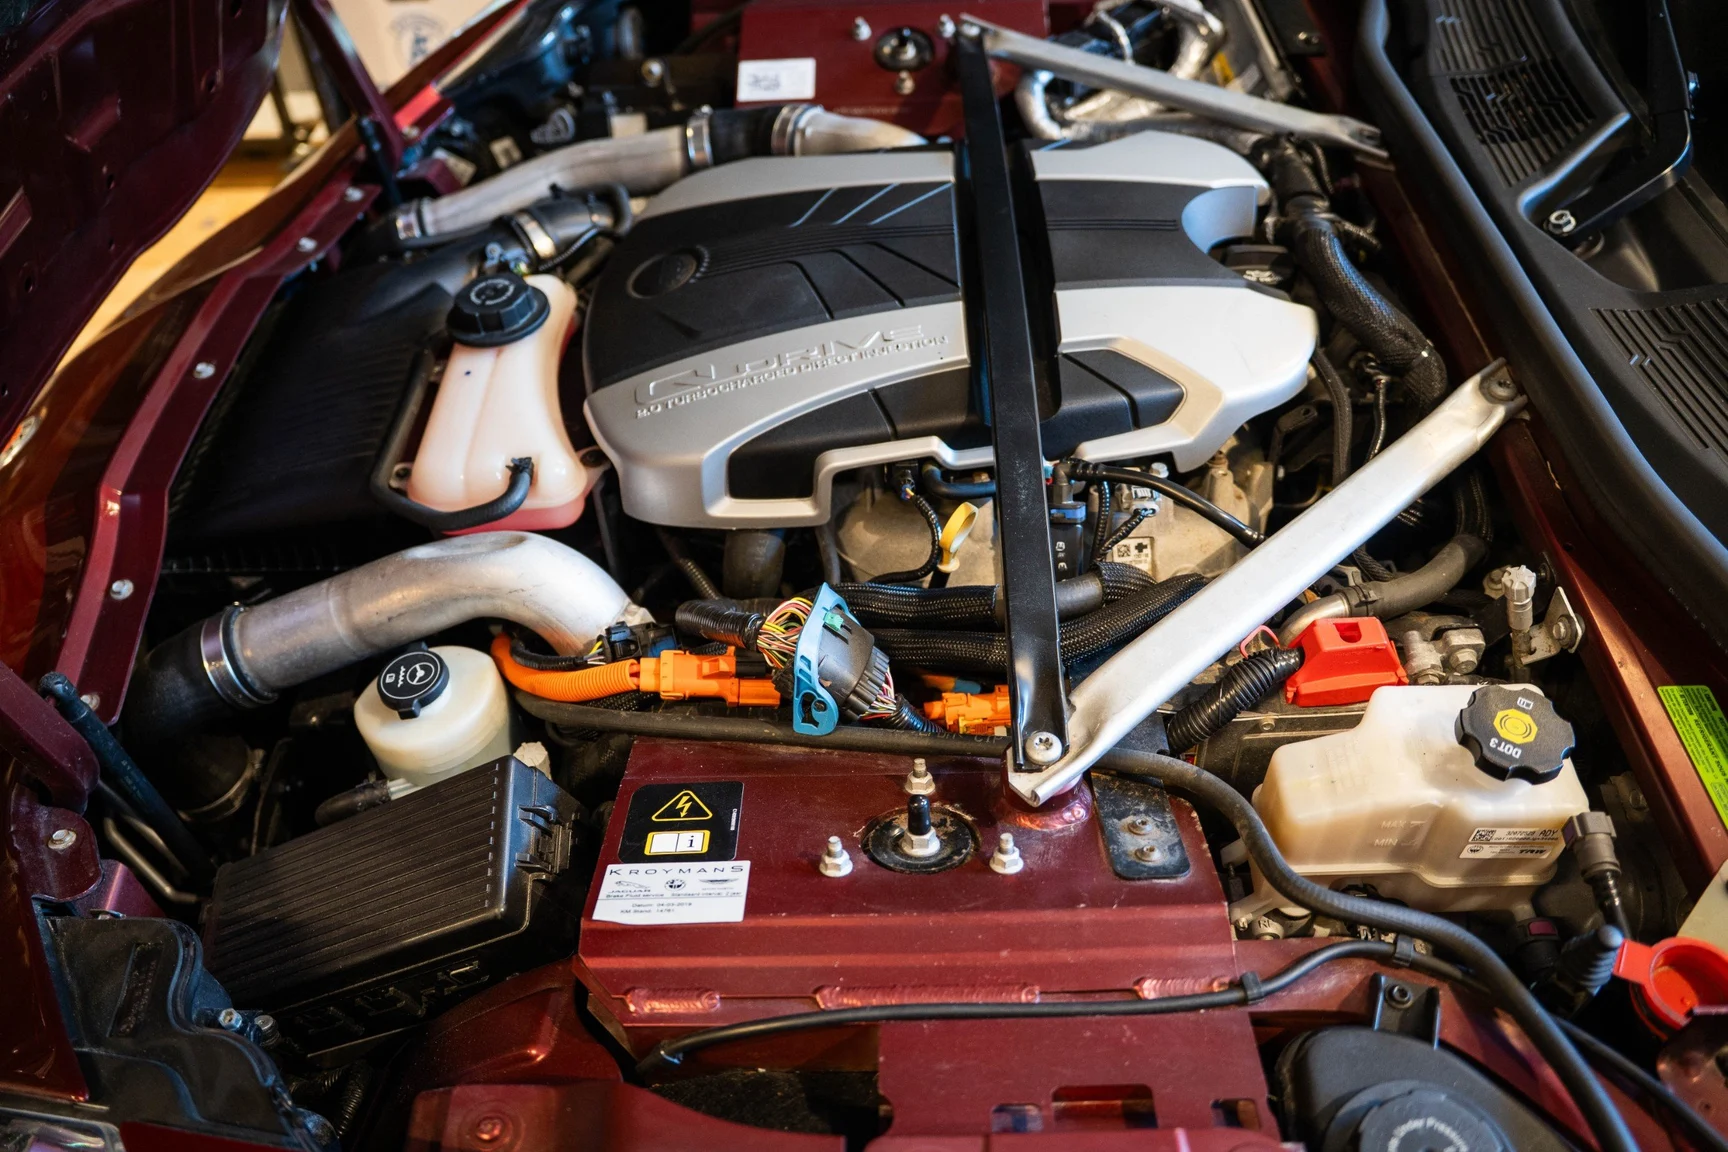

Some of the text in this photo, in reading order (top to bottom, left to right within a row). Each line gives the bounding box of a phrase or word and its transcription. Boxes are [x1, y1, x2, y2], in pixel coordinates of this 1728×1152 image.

[665, 366, 797, 409] TURBOCHARGED
[799, 351, 858, 373] DIRECT
[859, 335, 949, 359] INJECTION
[1489, 737, 1521, 759] DOT 3
[1694, 718, 1719, 759] REFRIGERANT
[1715, 760, 1727, 777] SOUS
[1381, 819, 1408, 829] MAX
[1539, 829, 1559, 837] ADY
[1374, 838, 1399, 847] MIN
[609, 866, 743, 876] KROYMANS
